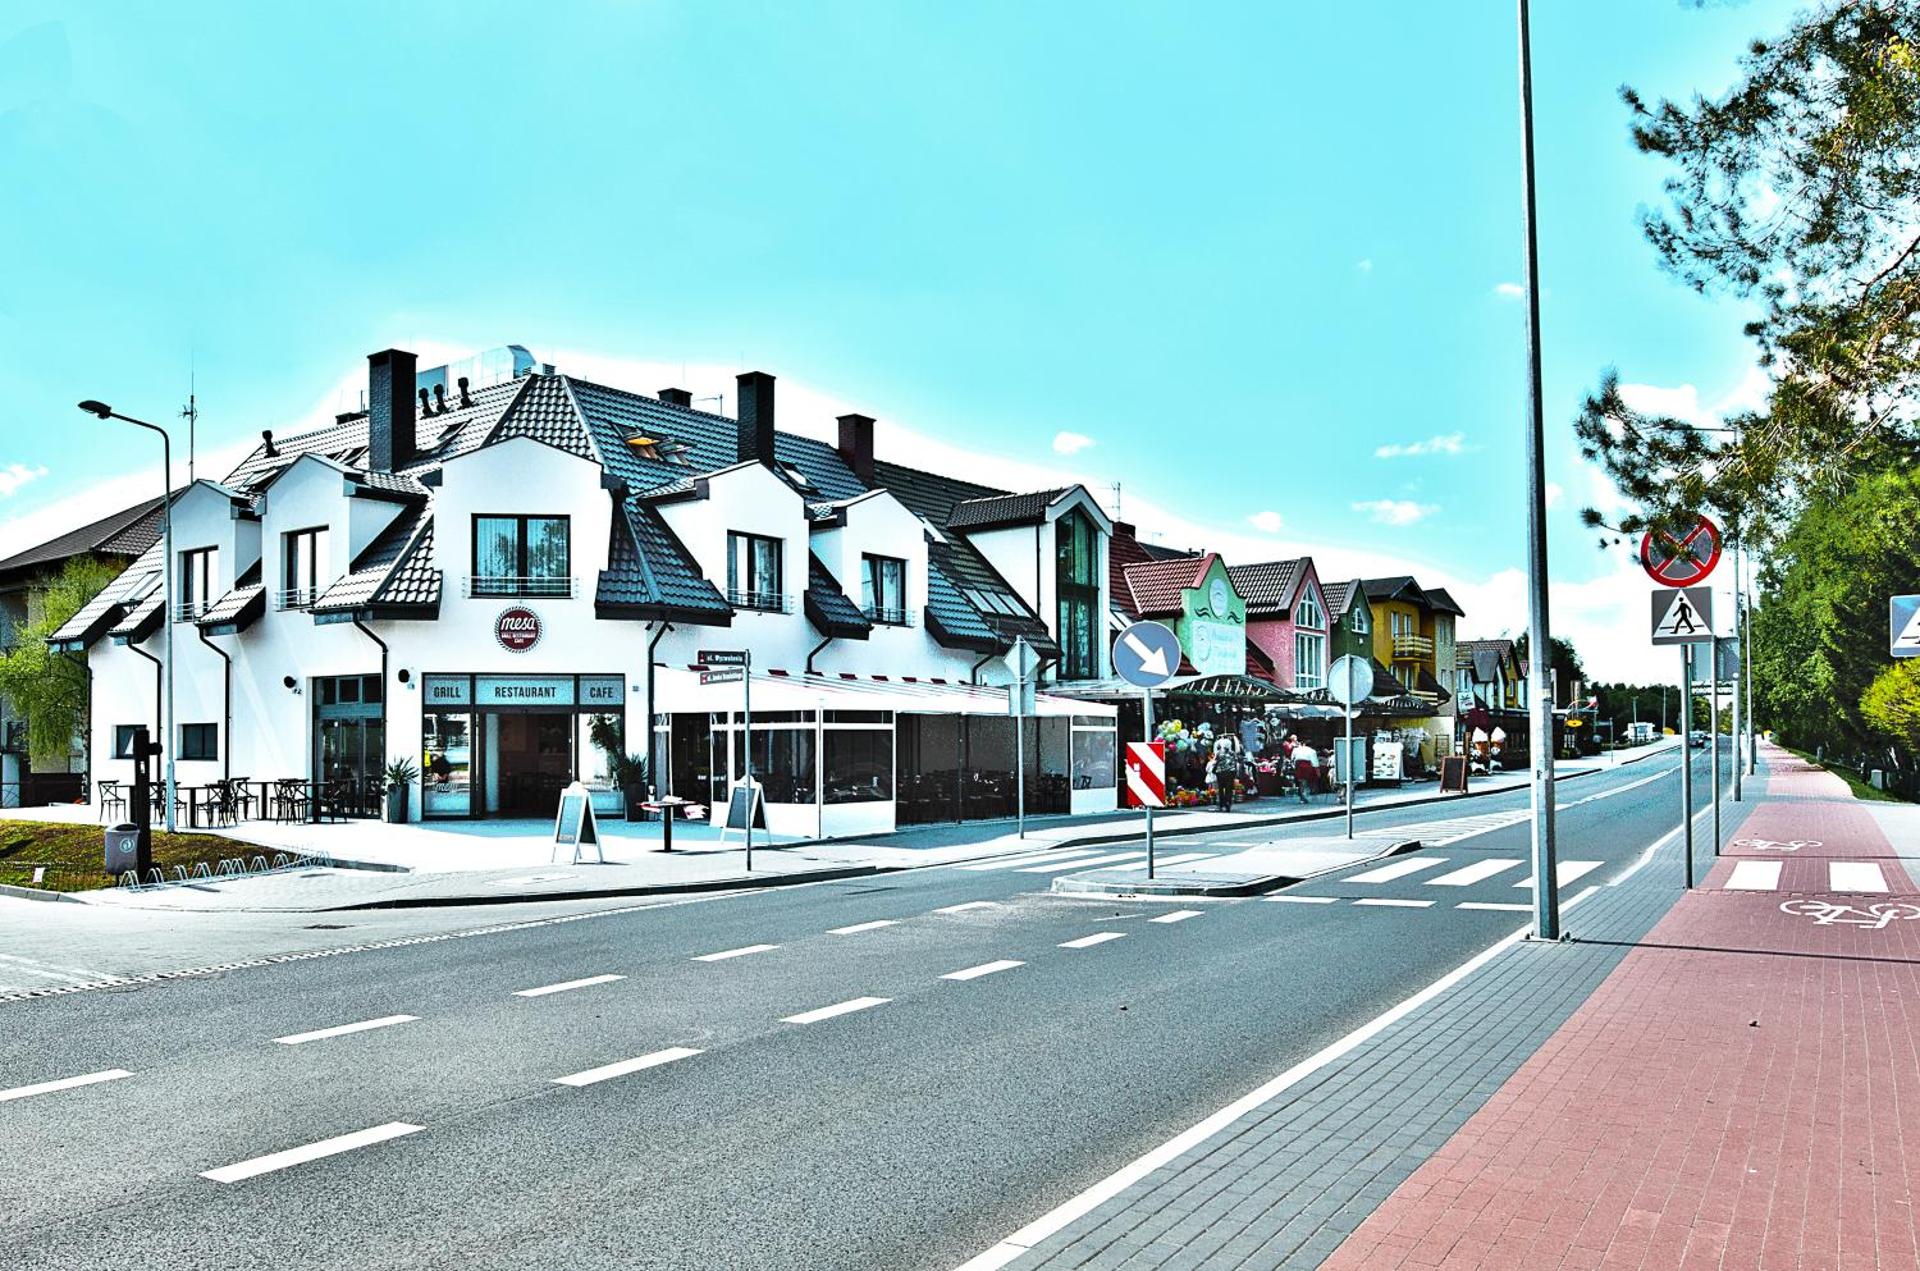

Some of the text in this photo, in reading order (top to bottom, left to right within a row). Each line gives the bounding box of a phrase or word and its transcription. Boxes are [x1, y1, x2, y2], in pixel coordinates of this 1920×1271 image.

[501, 617, 536, 630] mesa
[433, 685, 613, 699] GRILL RESTAURANT CAFE
